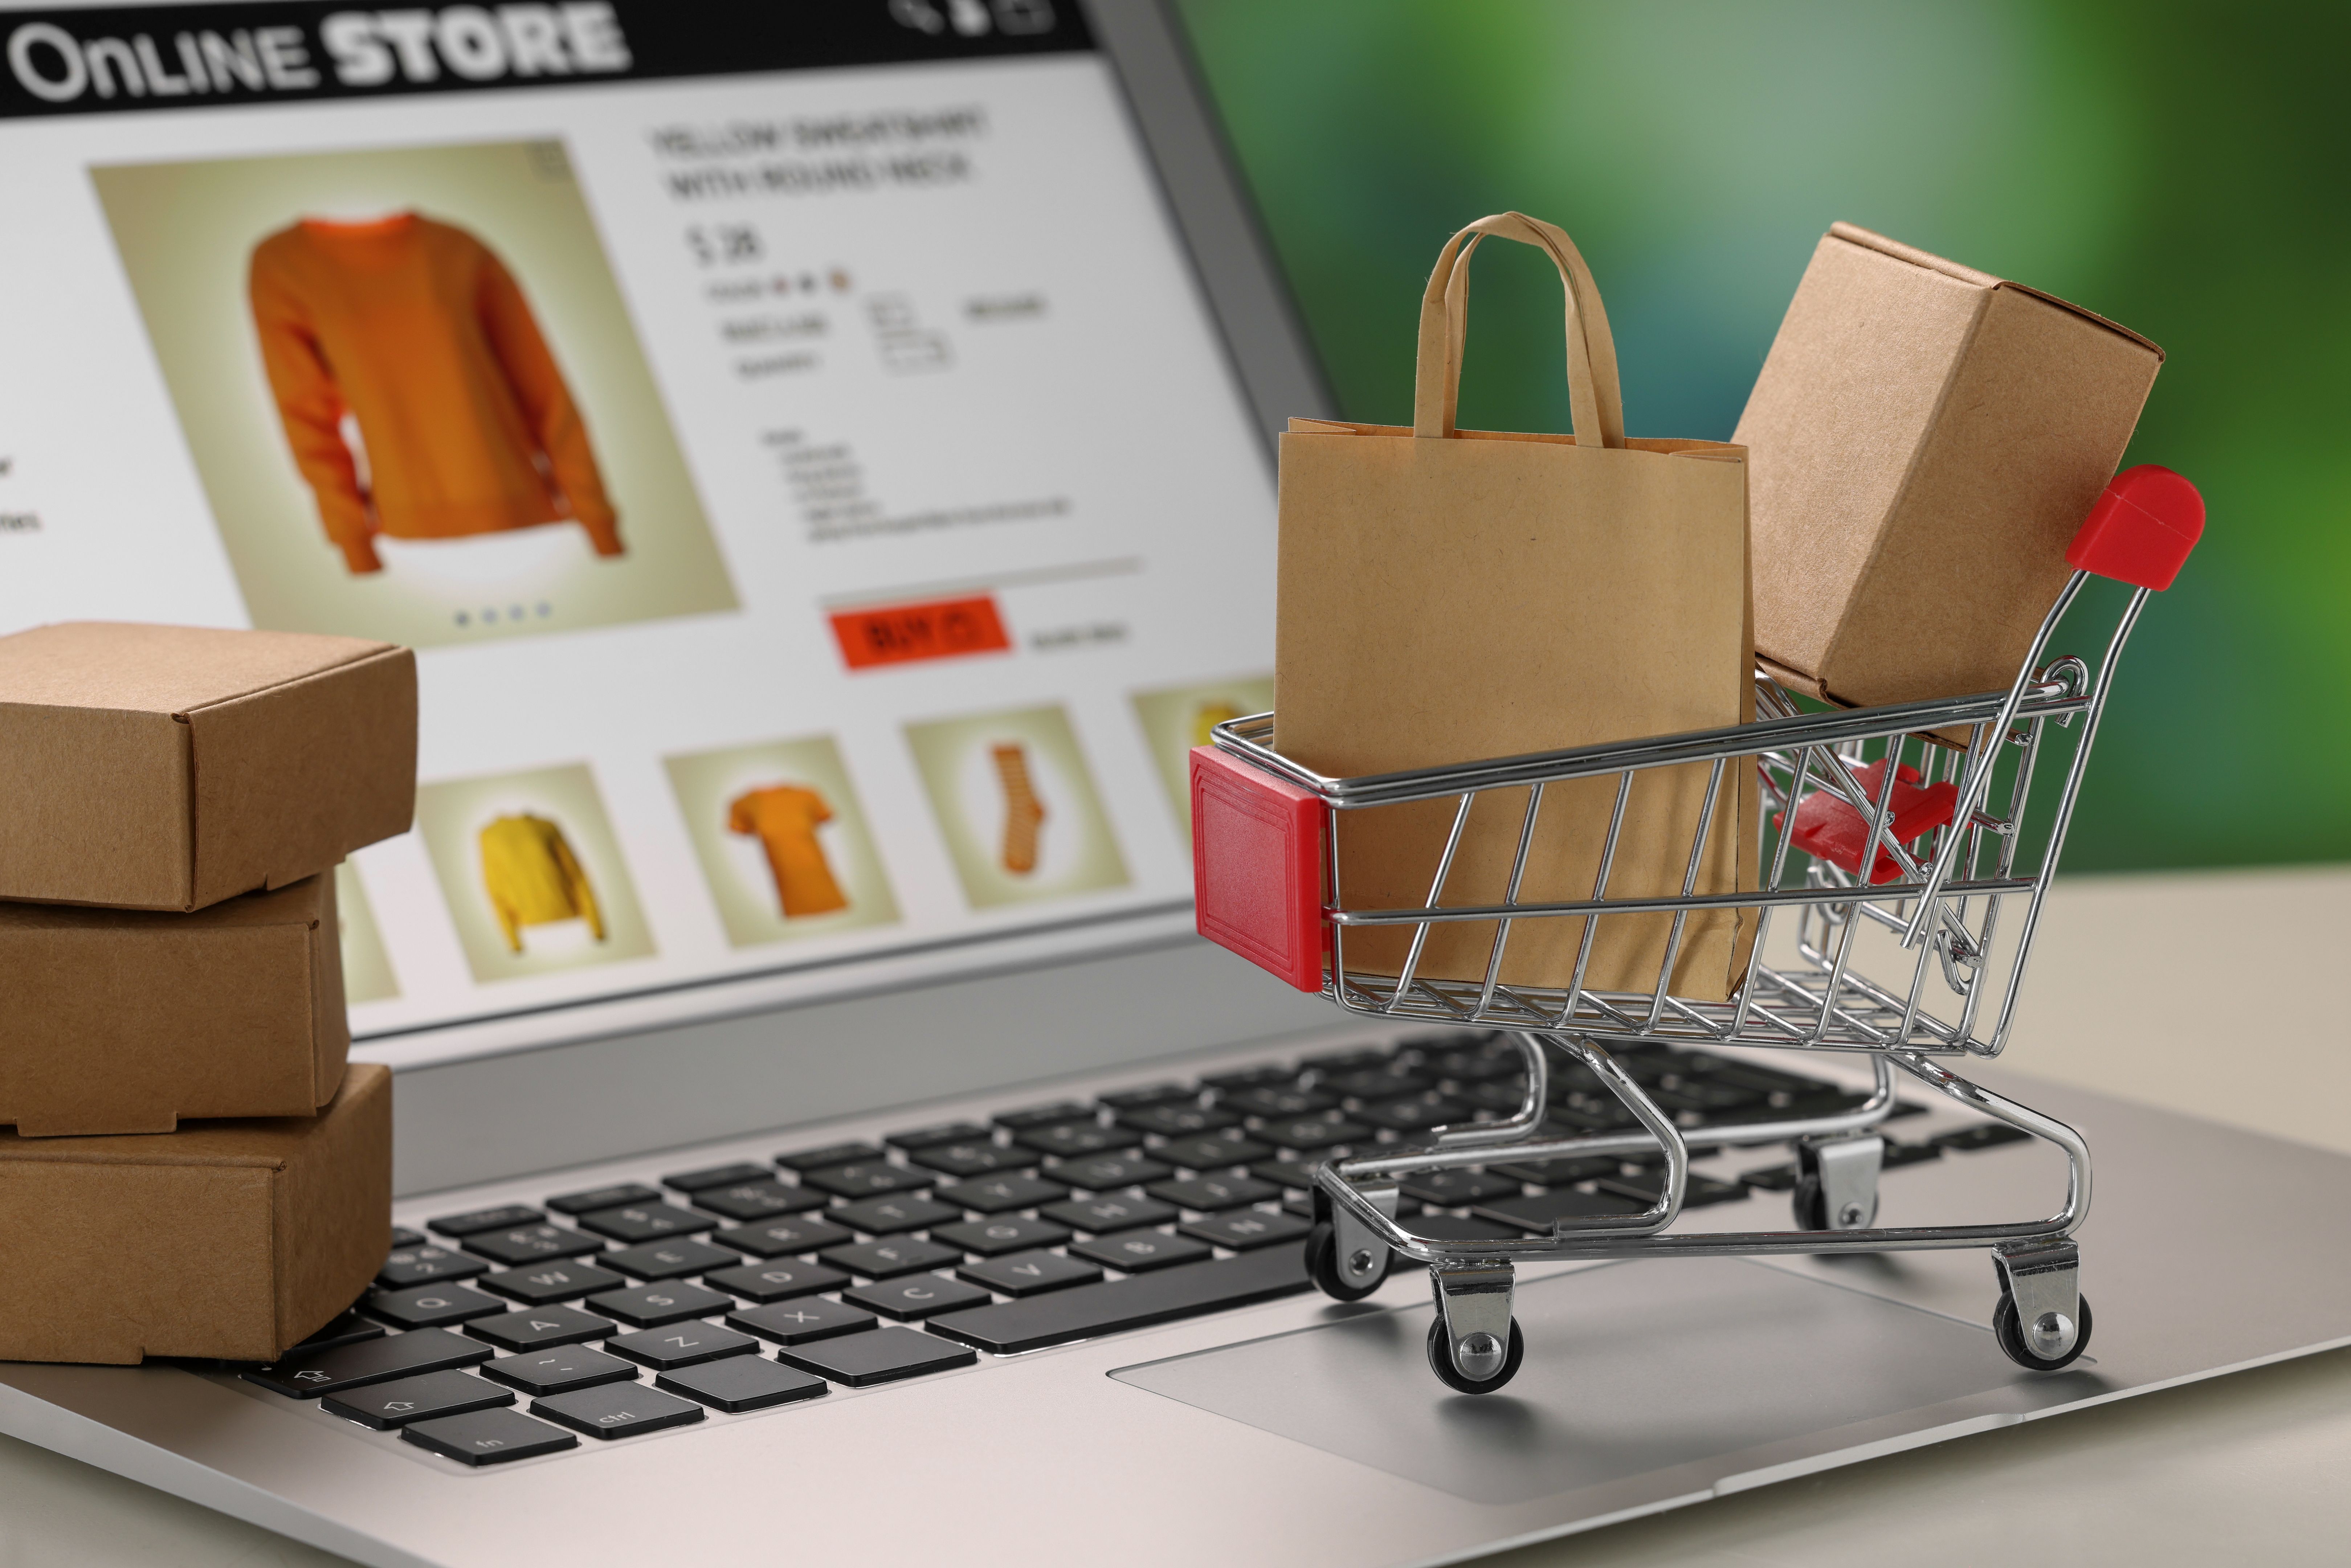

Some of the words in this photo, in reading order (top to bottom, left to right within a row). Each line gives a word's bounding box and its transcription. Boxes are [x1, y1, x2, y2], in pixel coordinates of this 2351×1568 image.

[320, 1, 633, 86] STORE
[654, 1251, 685, 1264] E
[1012, 1263, 1042, 1276] V
[529, 1271, 570, 1286] W
[762, 1271, 793, 1284] D
[902, 1287, 935, 1299] C
[416, 1298, 453, 1308] Q
[646, 1295, 674, 1306] S
[783, 1310, 820, 1323] X
[529, 1320, 560, 1331] A
[664, 1336, 699, 1348] Z
[599, 1411, 636, 1423] ctrl
[475, 1439, 504, 1449] fn
